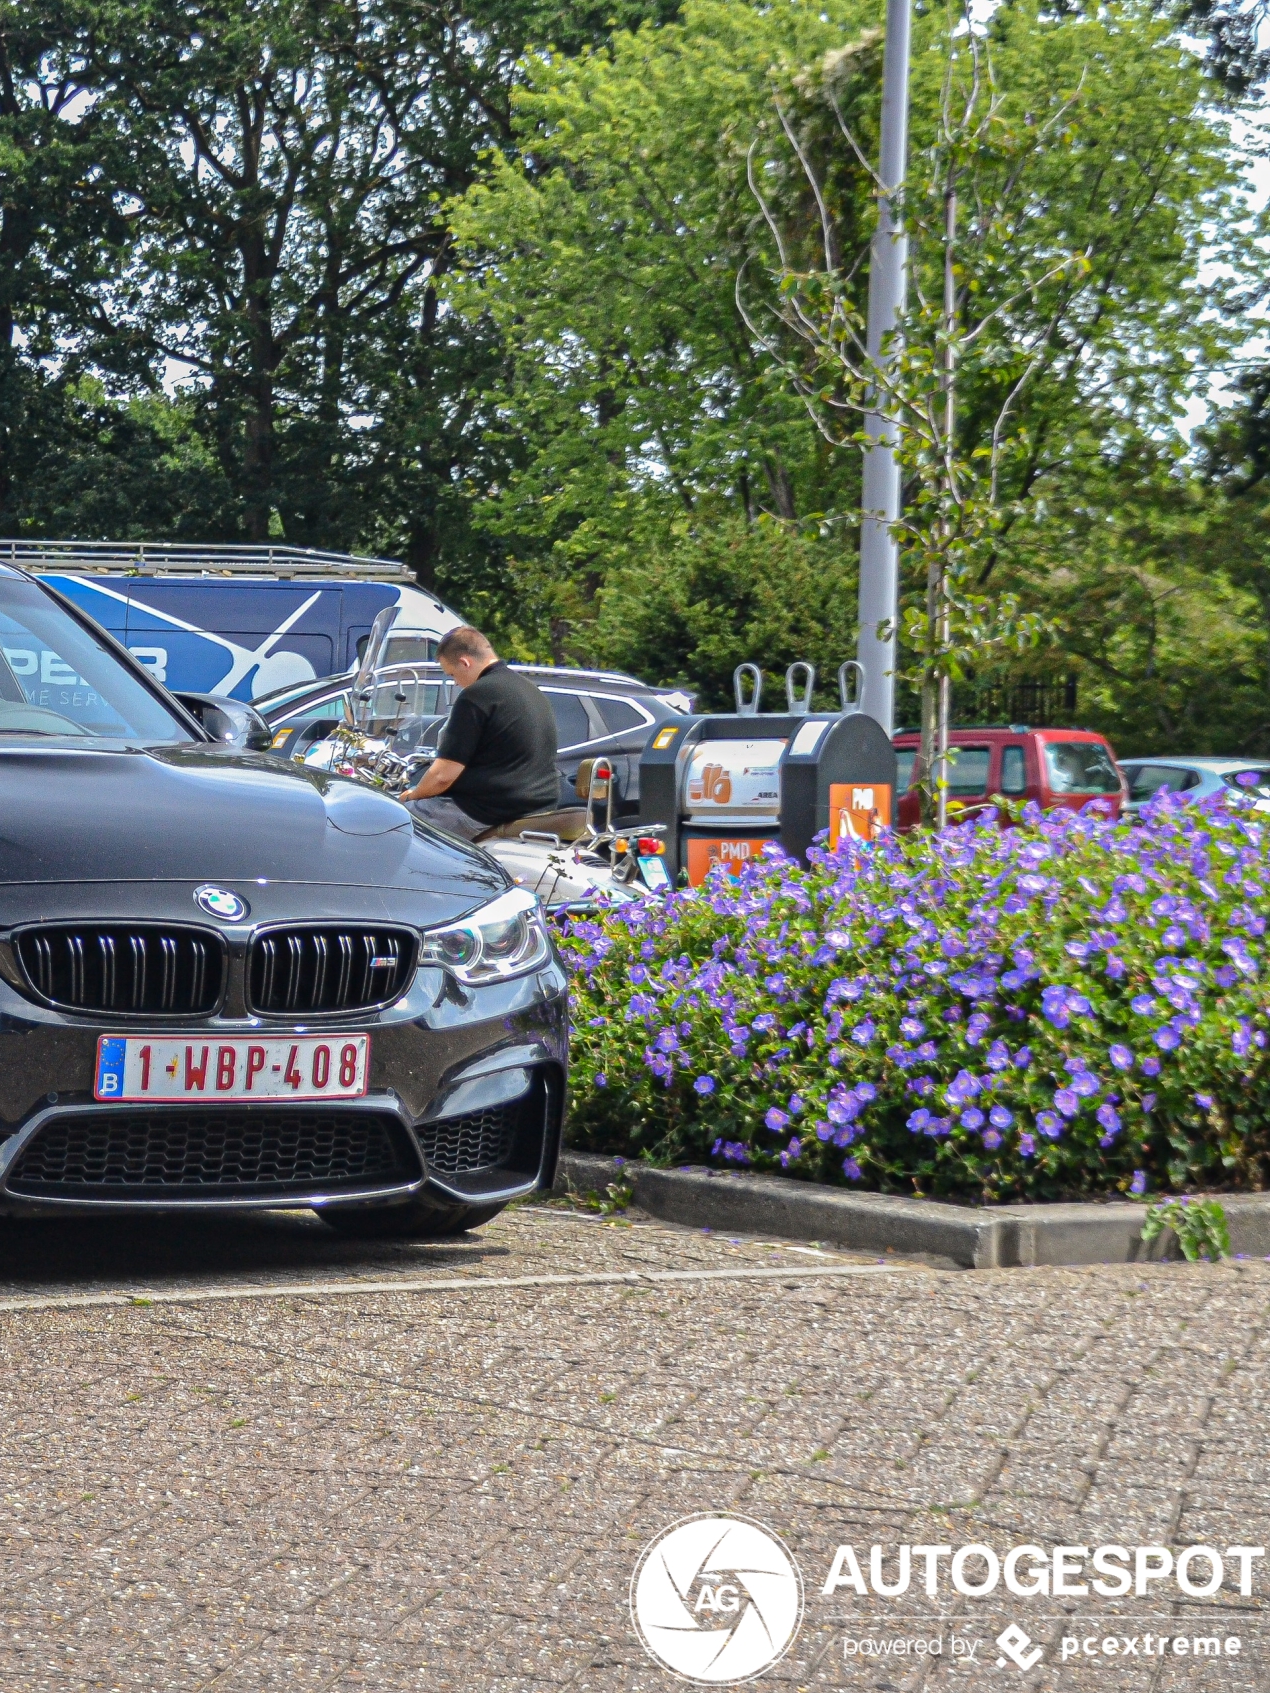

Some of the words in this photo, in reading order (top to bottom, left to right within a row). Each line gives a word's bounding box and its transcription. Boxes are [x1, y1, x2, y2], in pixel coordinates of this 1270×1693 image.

[720, 842, 751, 860] PMD
[102, 1073, 118, 1092] B
[139, 1043, 357, 1091] 1-WBP-408
